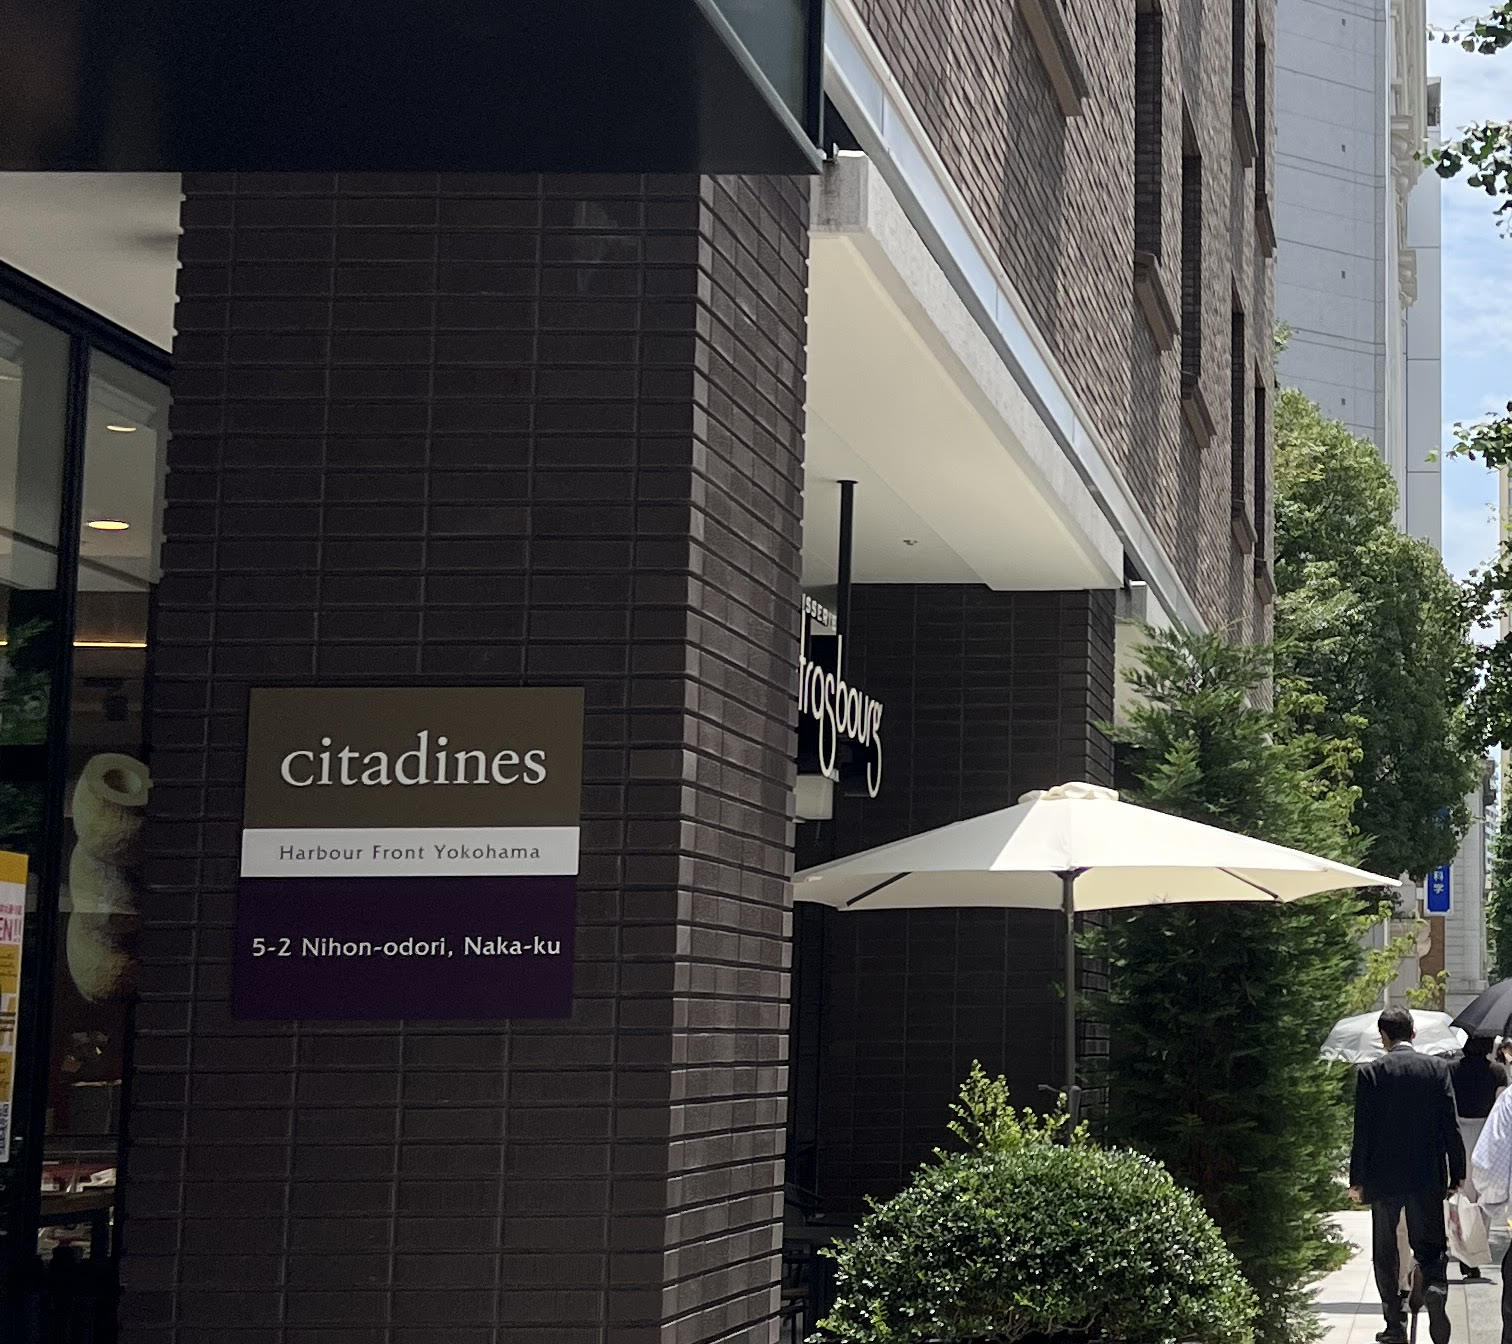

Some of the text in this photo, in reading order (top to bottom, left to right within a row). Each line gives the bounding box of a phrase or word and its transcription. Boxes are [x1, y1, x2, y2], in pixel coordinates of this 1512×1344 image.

[281, 729, 547, 786] citadines
[279, 843, 540, 861] Harbour Front Yokohama
[252, 935, 562, 958] 5-2 Nihon-odori, Naka-ku
